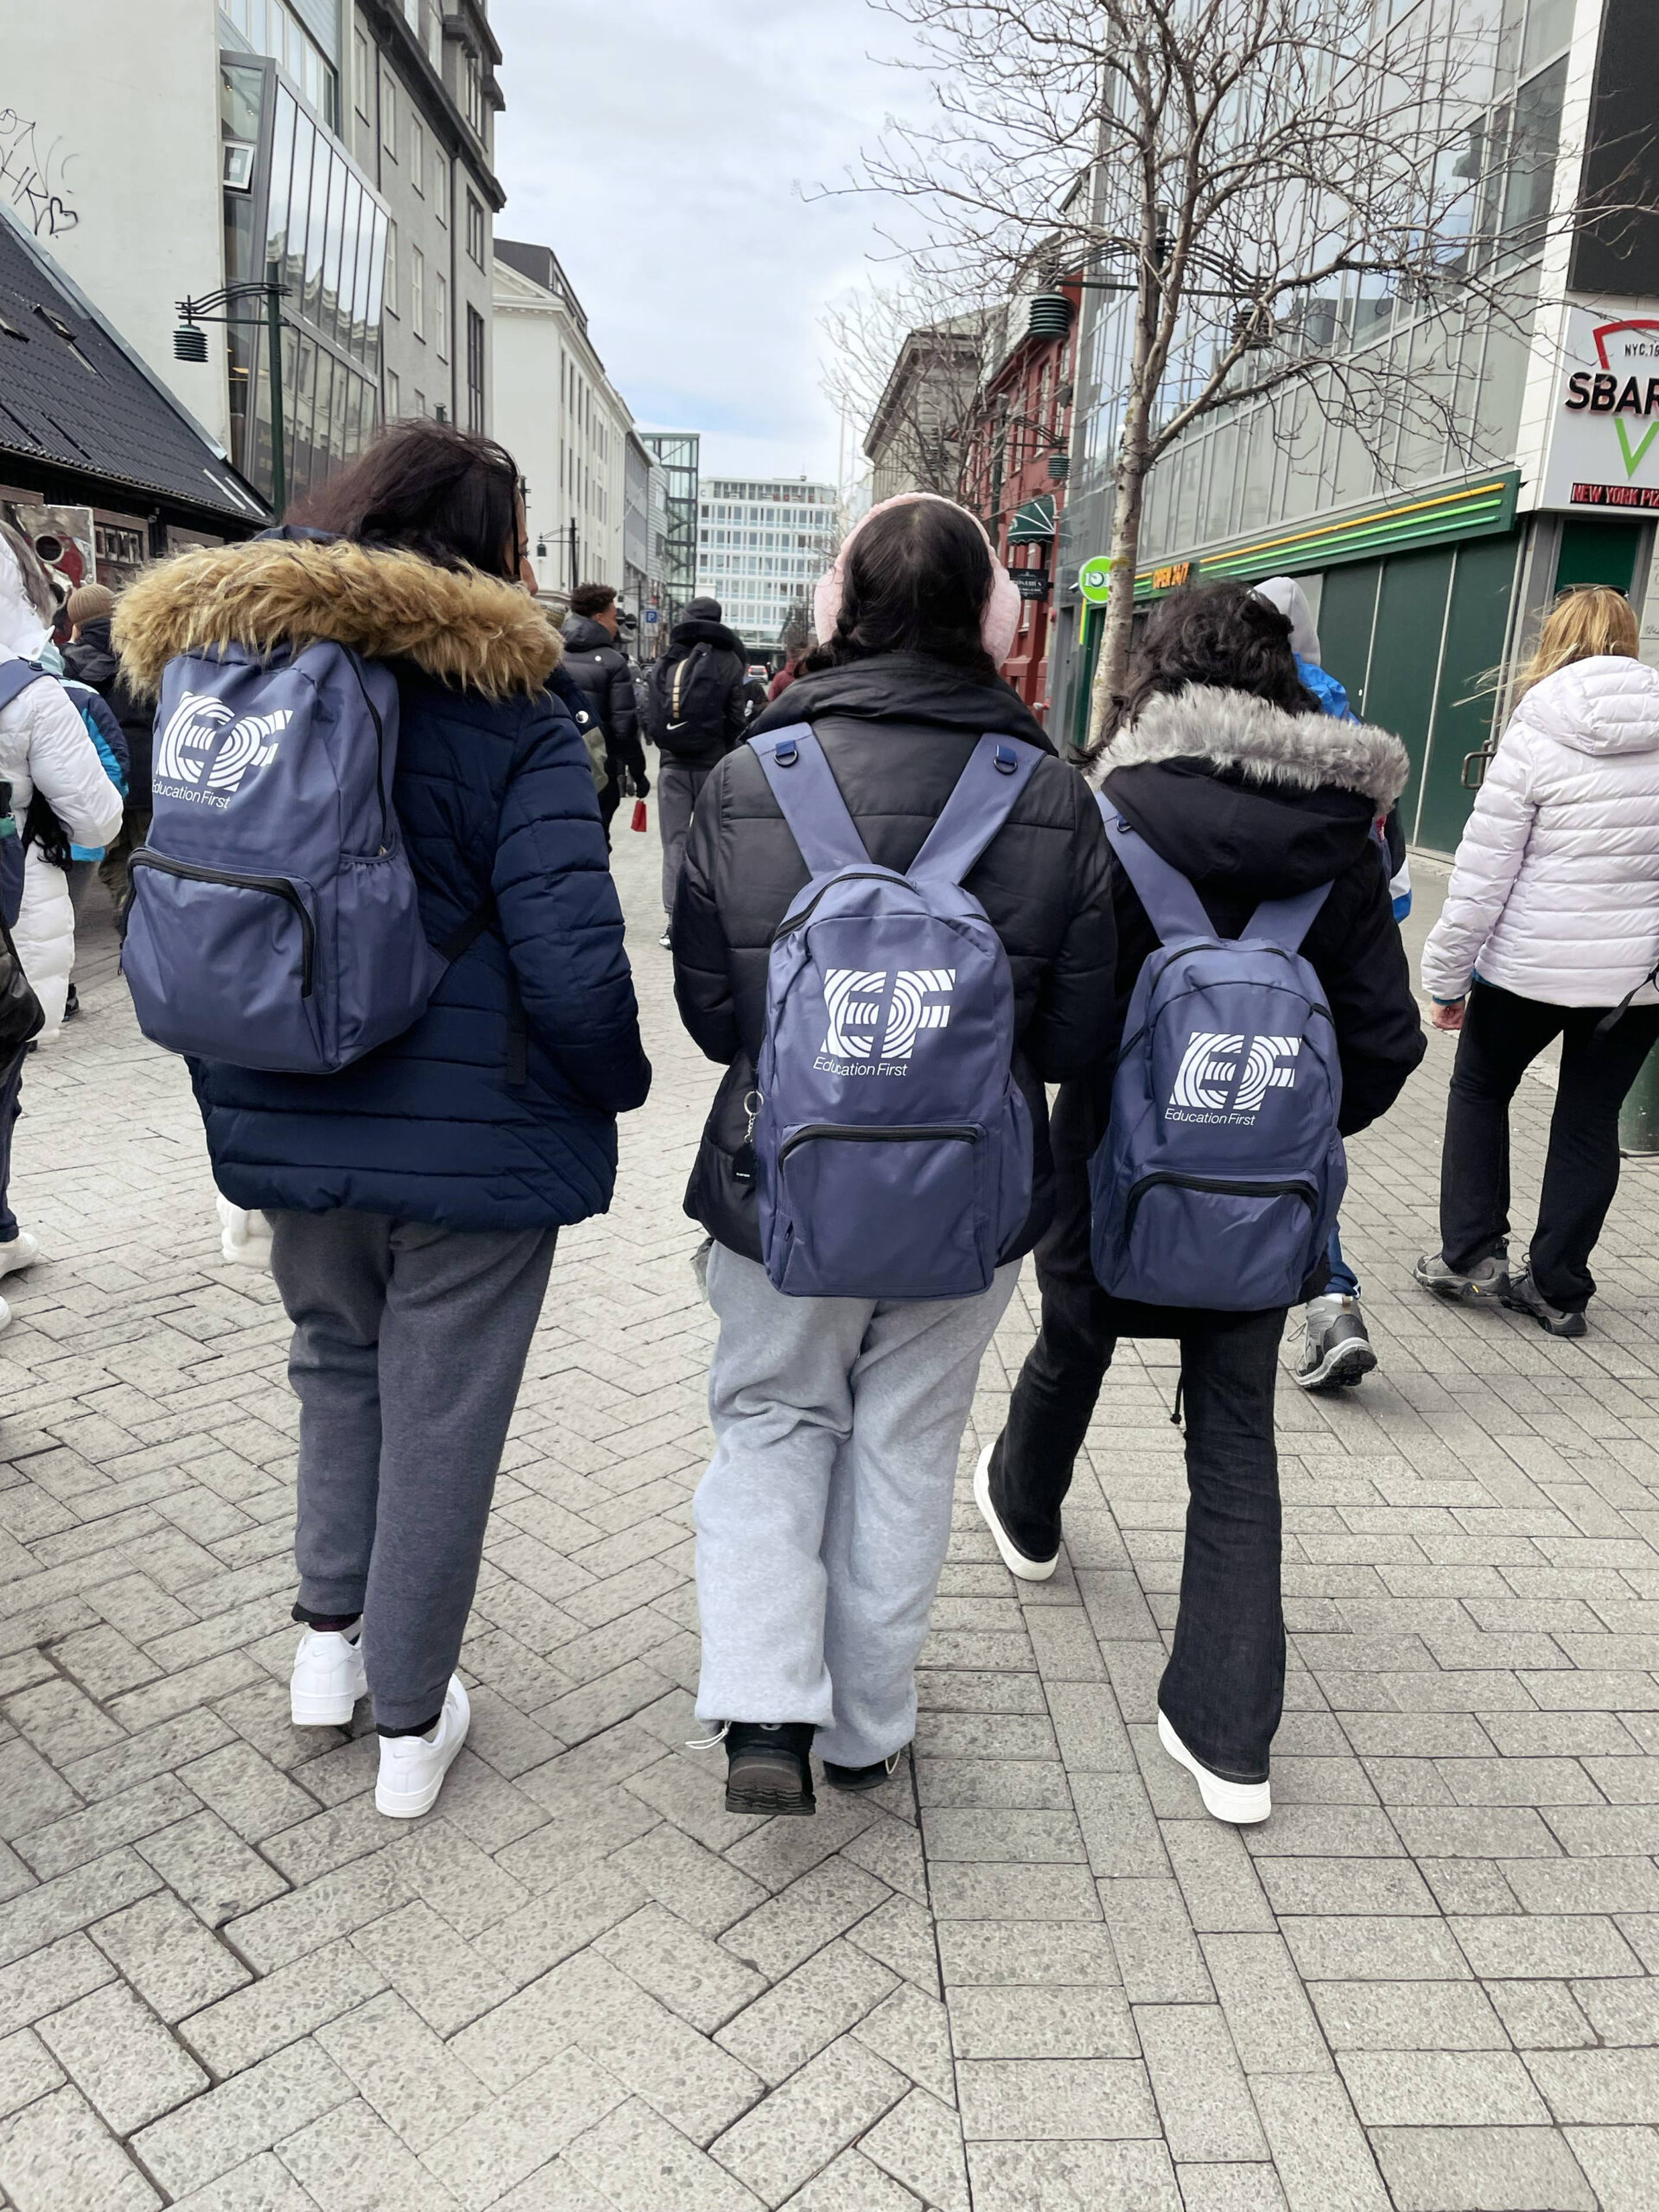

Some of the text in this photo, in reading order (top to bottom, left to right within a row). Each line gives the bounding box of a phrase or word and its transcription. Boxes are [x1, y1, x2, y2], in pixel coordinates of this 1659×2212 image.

[1571, 484, 1601, 502] NEW
[1606, 487, 1638, 505] YORK
[648, 613, 655, 622] P
[156, 691, 293, 792] EF
[152, 779, 231, 809] Education First
[820, 968, 956, 1059] EF
[813, 1056, 908, 1076] Education First
[1169, 1032, 1302, 1111] EF
[1164, 1108, 1256, 1126] Education First
